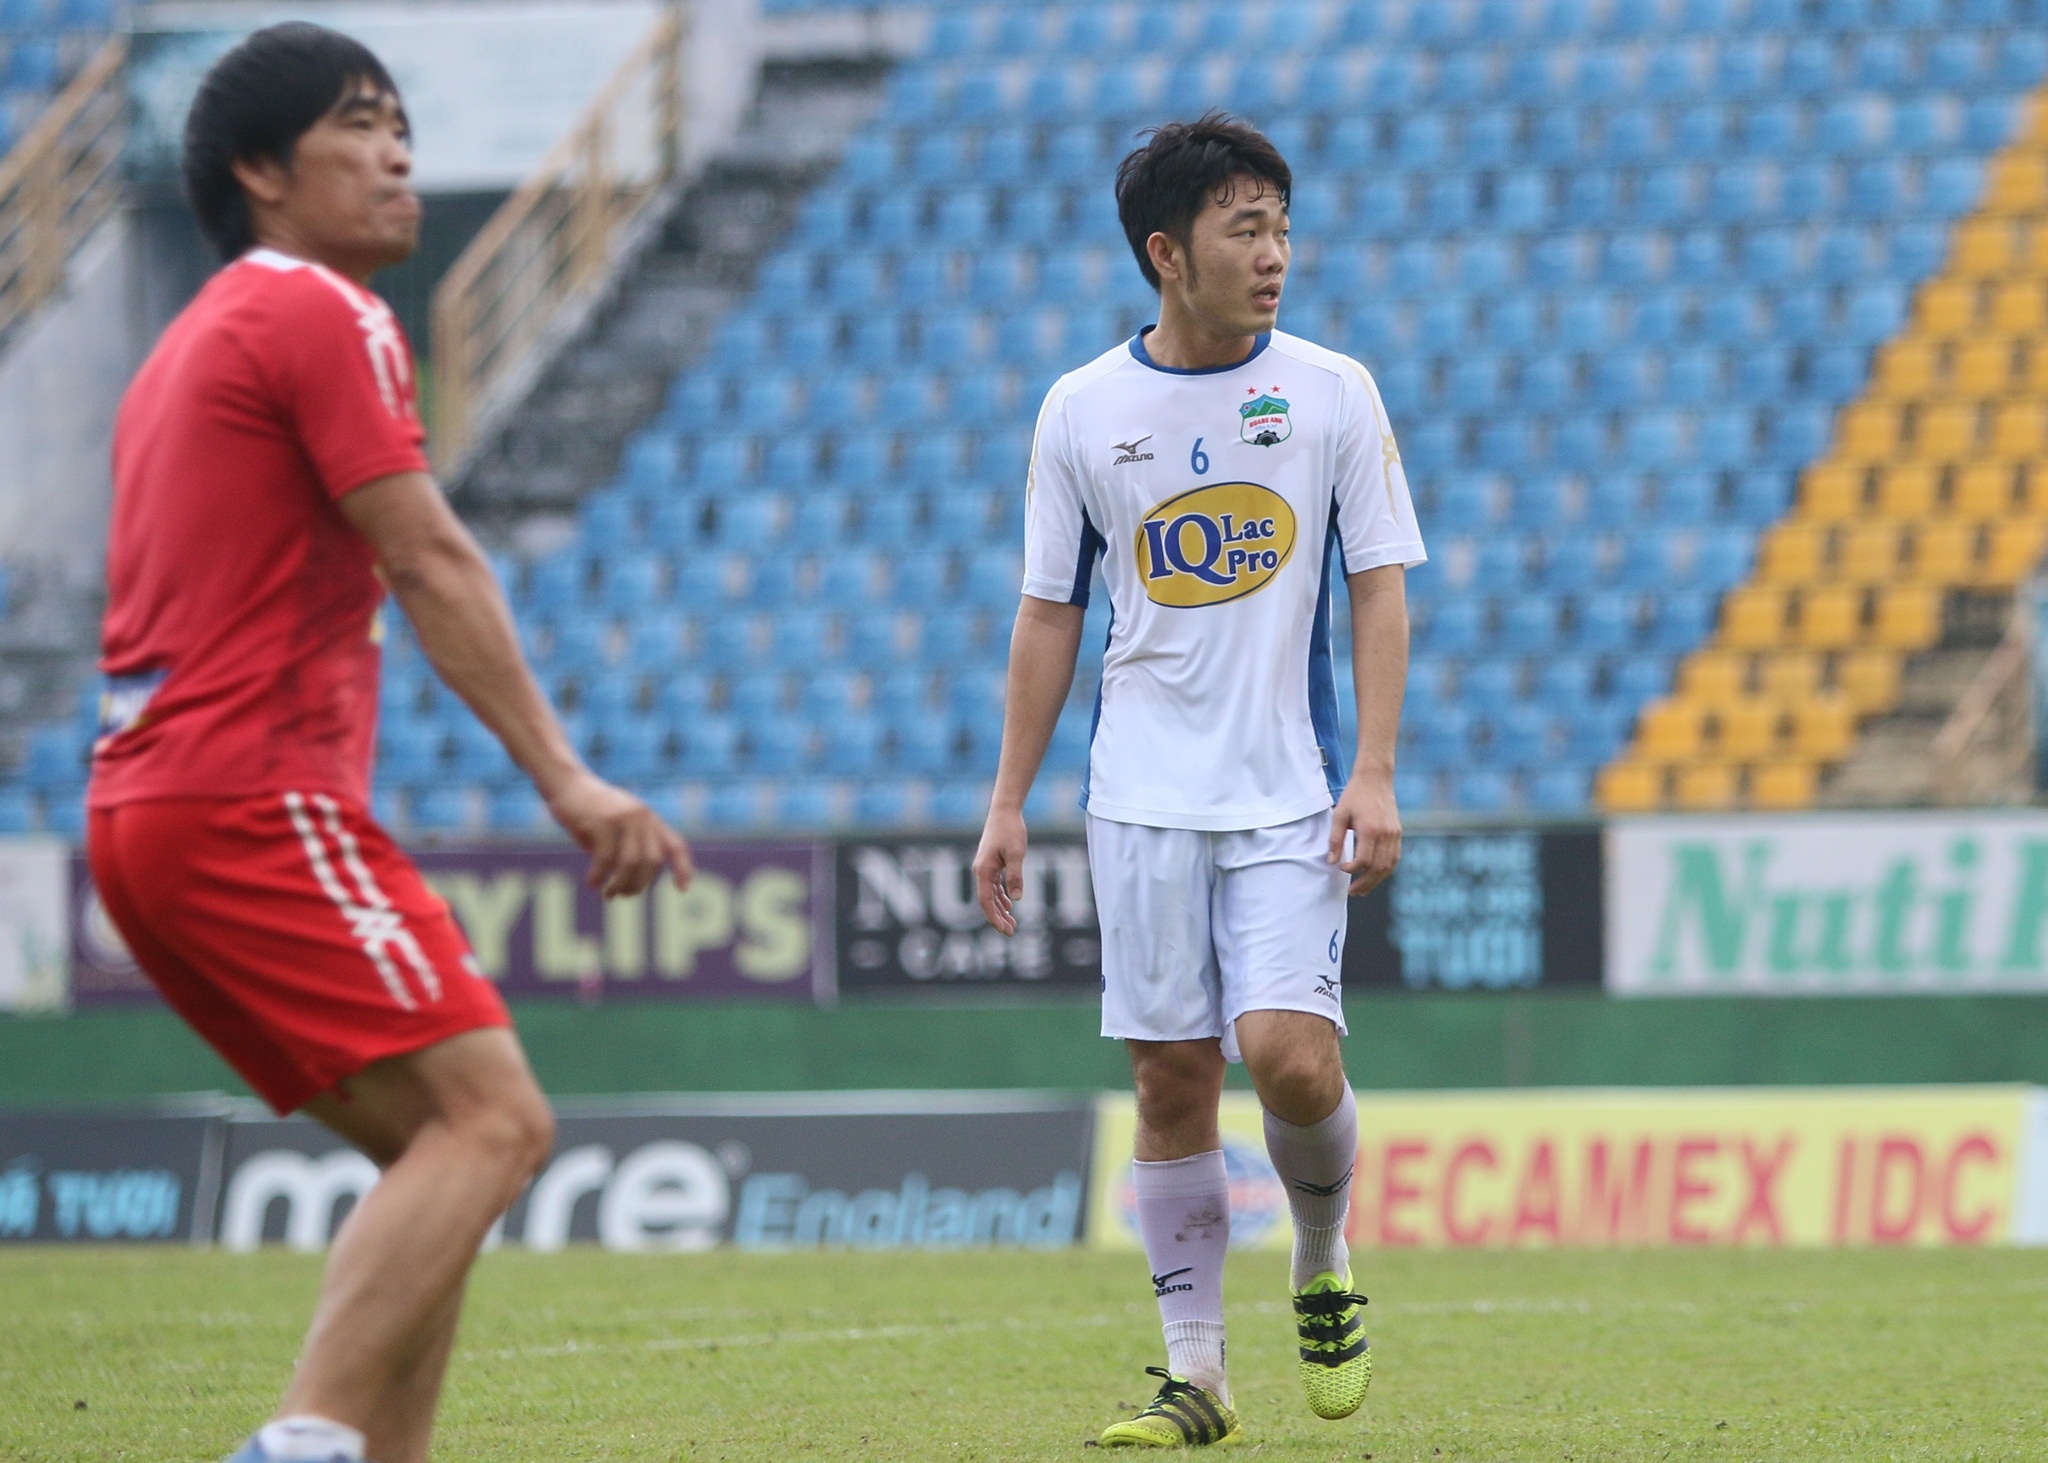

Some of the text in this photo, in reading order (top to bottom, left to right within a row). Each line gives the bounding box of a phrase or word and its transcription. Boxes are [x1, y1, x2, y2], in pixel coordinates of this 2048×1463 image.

[1191, 437, 1209, 475] 6
[1143, 513, 1275, 586] IQ Lac
[1226, 549, 1279, 575] Pro
[1328, 929, 1338, 963] 6
[218, 1138, 740, 1254] mre
[1828, 1134, 2000, 1246] IDC
